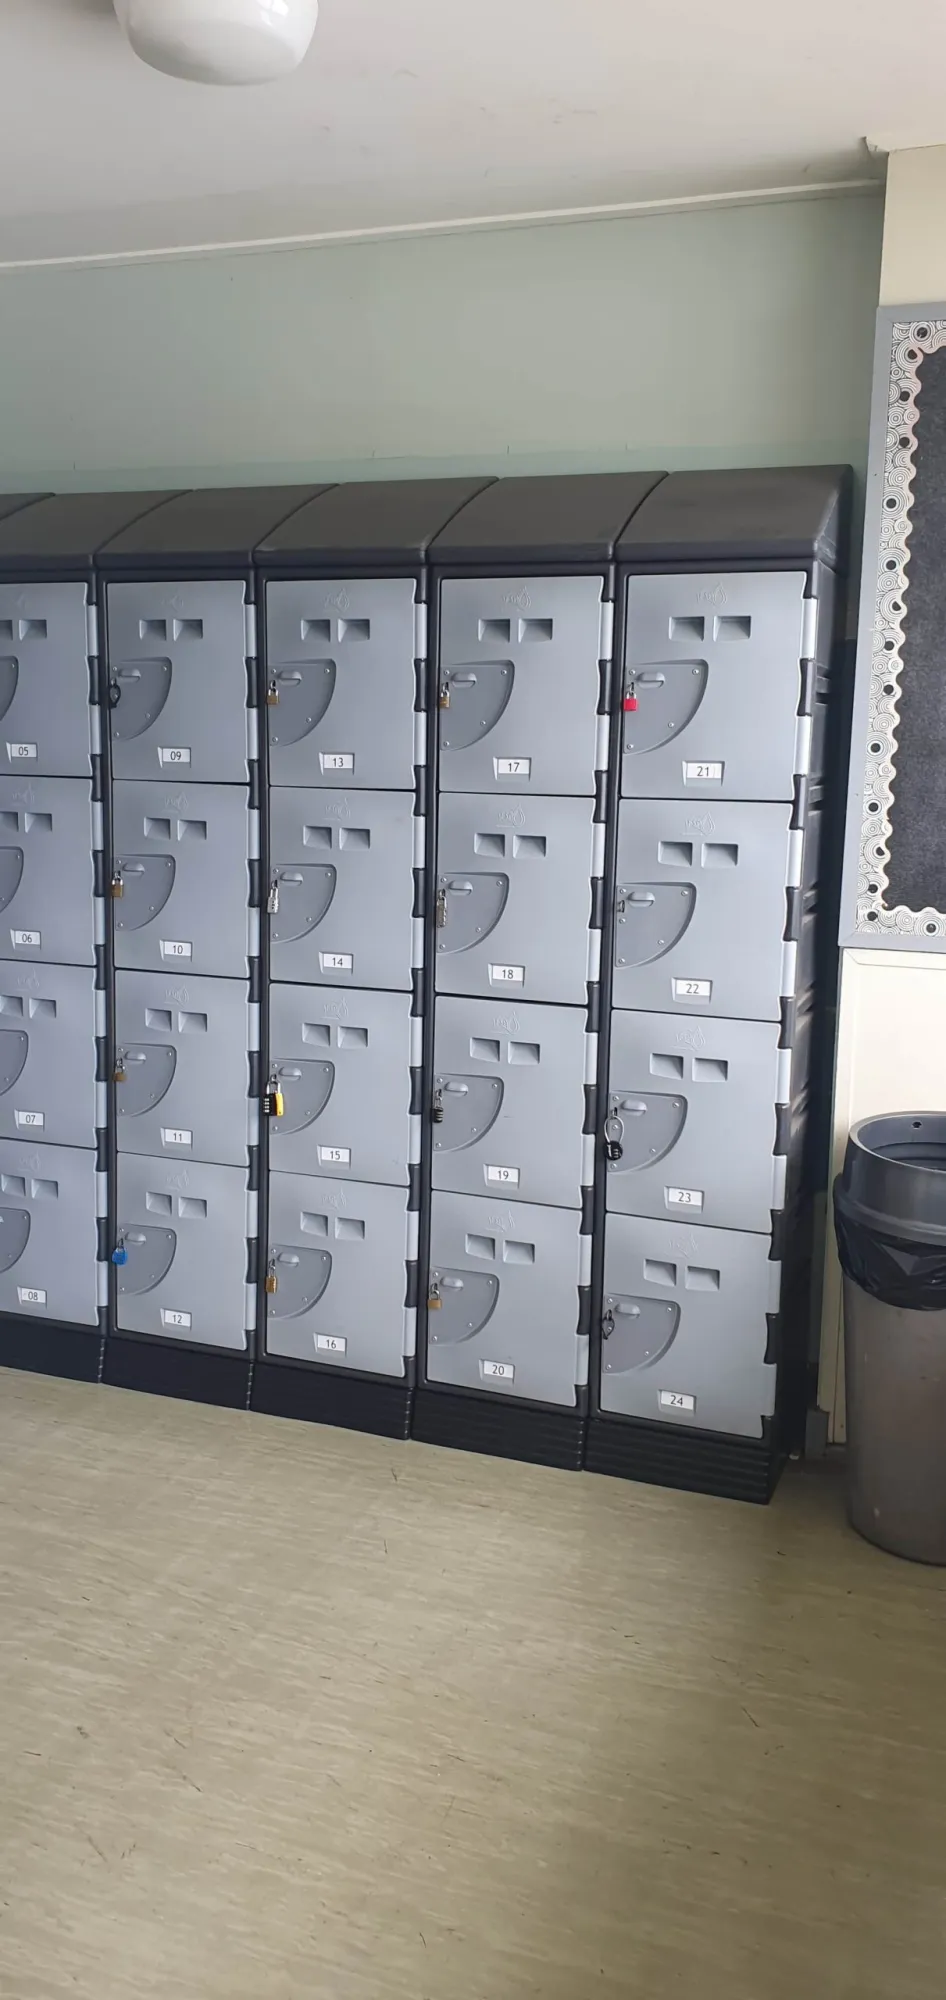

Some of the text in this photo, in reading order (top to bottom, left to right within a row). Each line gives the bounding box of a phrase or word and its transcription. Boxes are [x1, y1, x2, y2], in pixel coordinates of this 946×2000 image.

[18, 746, 29, 756] 05
[170, 750, 182, 761] 09
[333, 757, 344, 767] 13
[507, 762, 520, 773] 17
[696, 766, 710, 777] 21
[21, 933, 33, 943] 06
[173, 944, 183, 954] 10
[332, 957, 343, 967] 14
[502, 969, 514, 979] 18
[686, 983, 699, 994] 22
[25, 1115, 36, 1124] 07
[173, 1132, 182, 1141] 11
[330, 1150, 341, 1160] 15
[498, 1170, 509, 1180] 19
[678, 1191, 691, 1202] 23
[28, 1291, 39, 1301] 08
[172, 1314, 183, 1324] 12
[326, 1339, 337, 1349] 16
[492, 1364, 505, 1375] 20
[670, 1394, 683, 1406] 24
